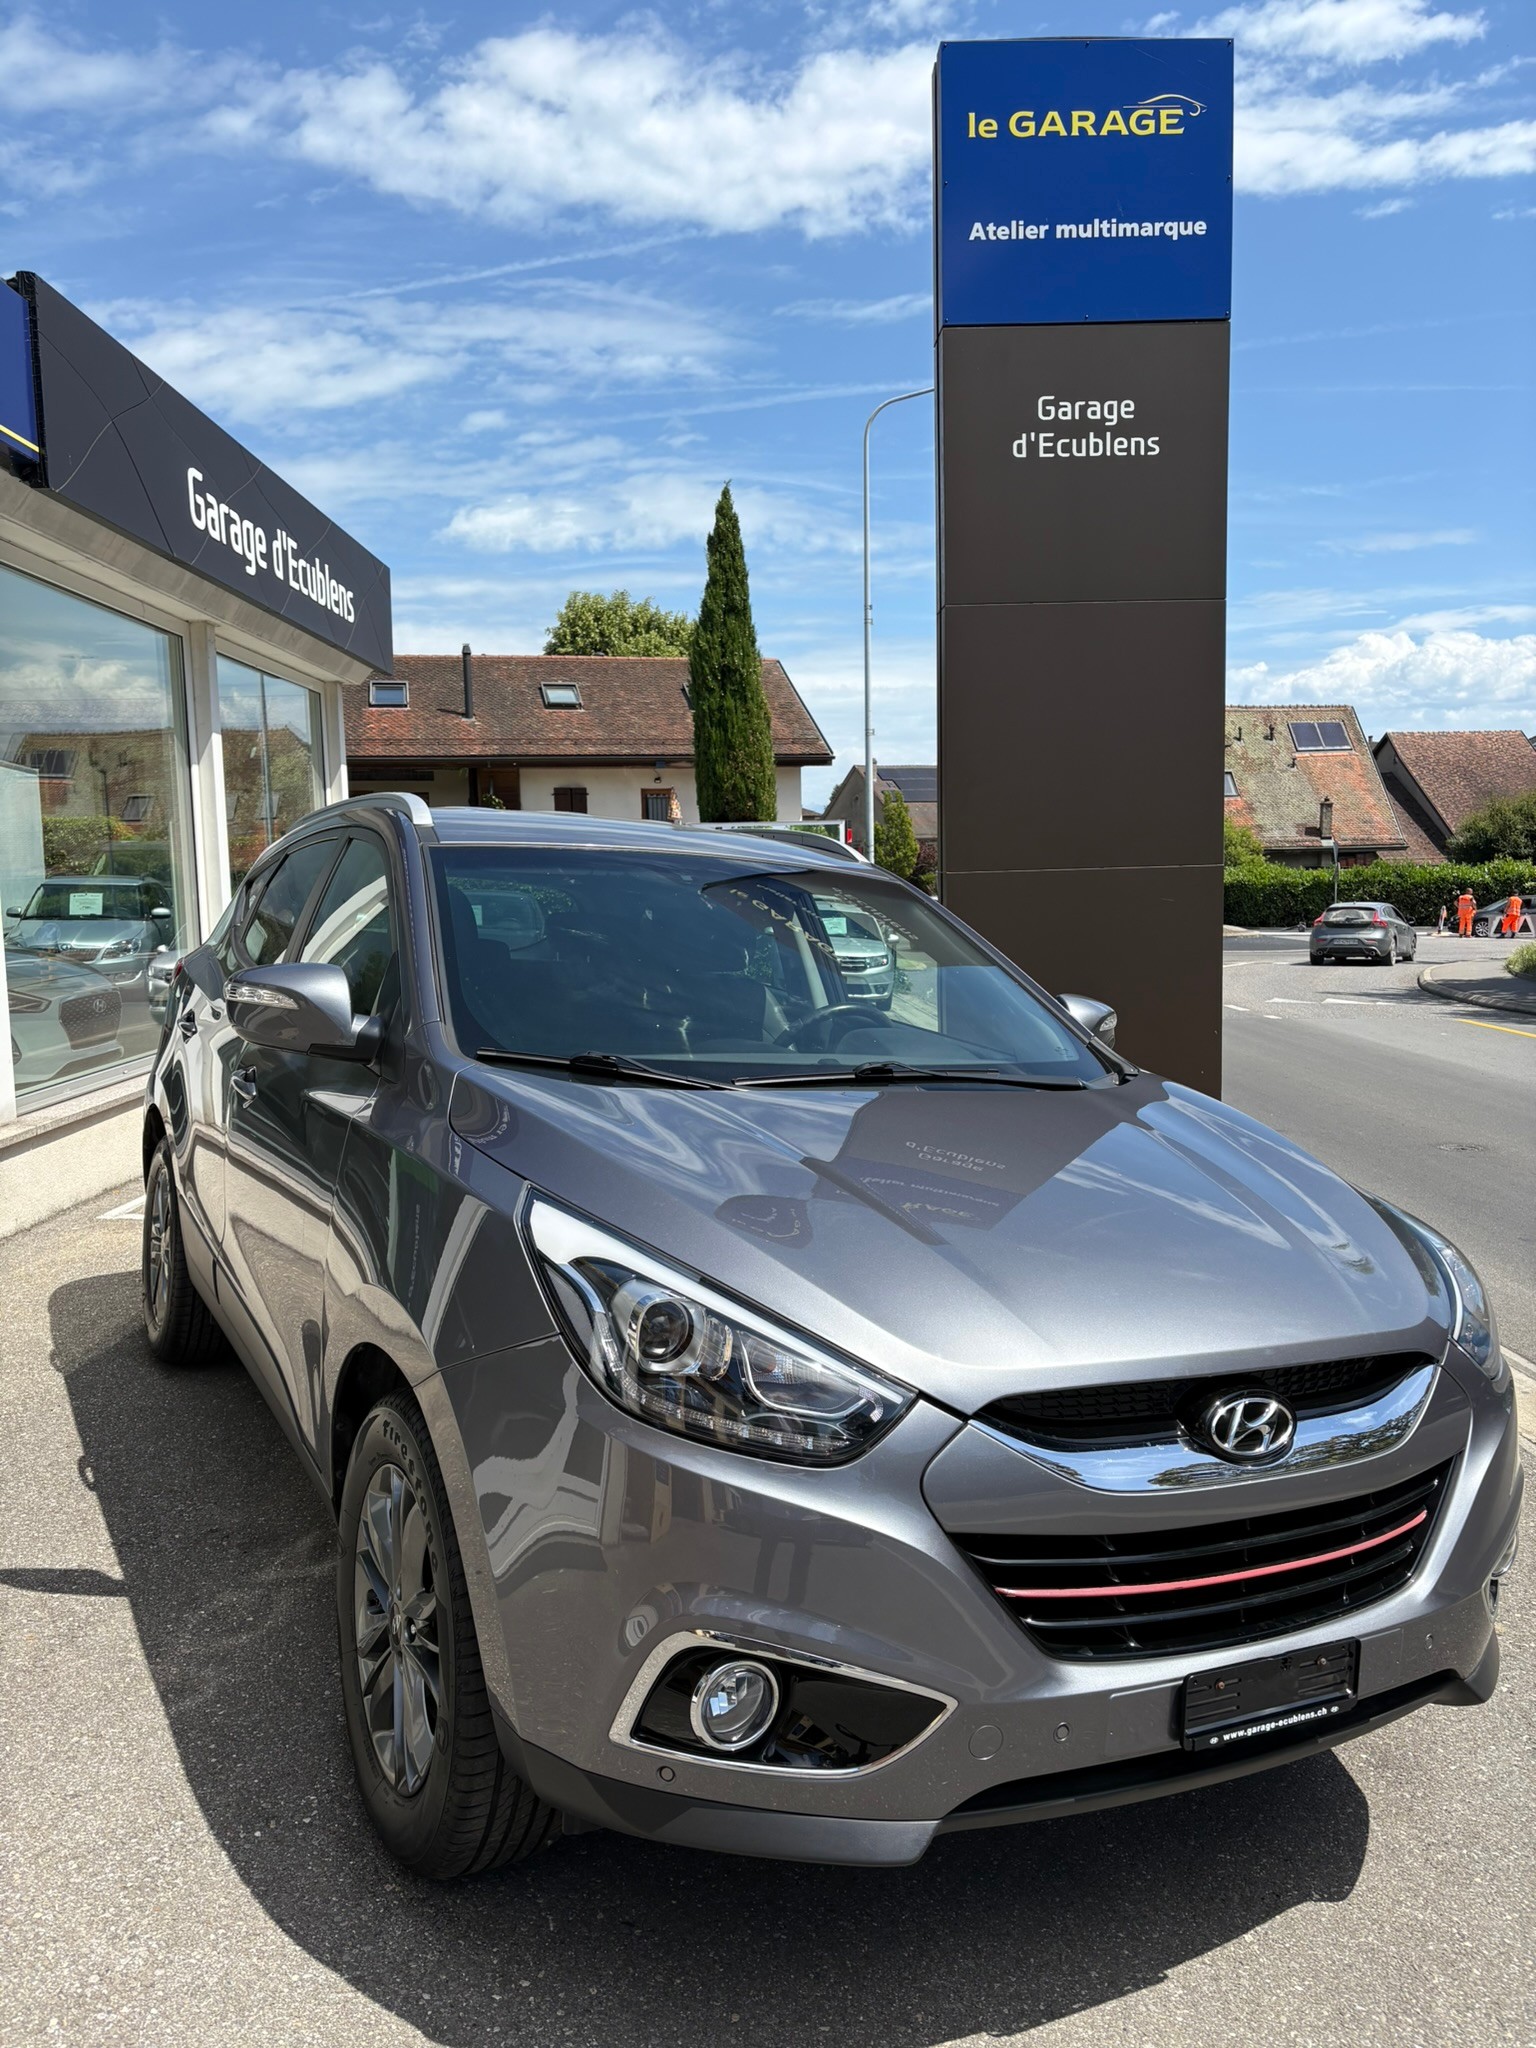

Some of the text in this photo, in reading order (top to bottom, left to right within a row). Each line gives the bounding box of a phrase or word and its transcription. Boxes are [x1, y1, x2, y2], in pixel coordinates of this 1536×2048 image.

[967, 108, 1185, 139] le GARAGE
[969, 218, 1207, 241] Atelier multimarque
[1037, 395, 1135, 426] Garage
[1012, 431, 1161, 459] d'Ecublens
[188, 467, 355, 624] Garage d'Ecublens
[1223, 1708, 1327, 1741] www.garage-ecublens.ch
